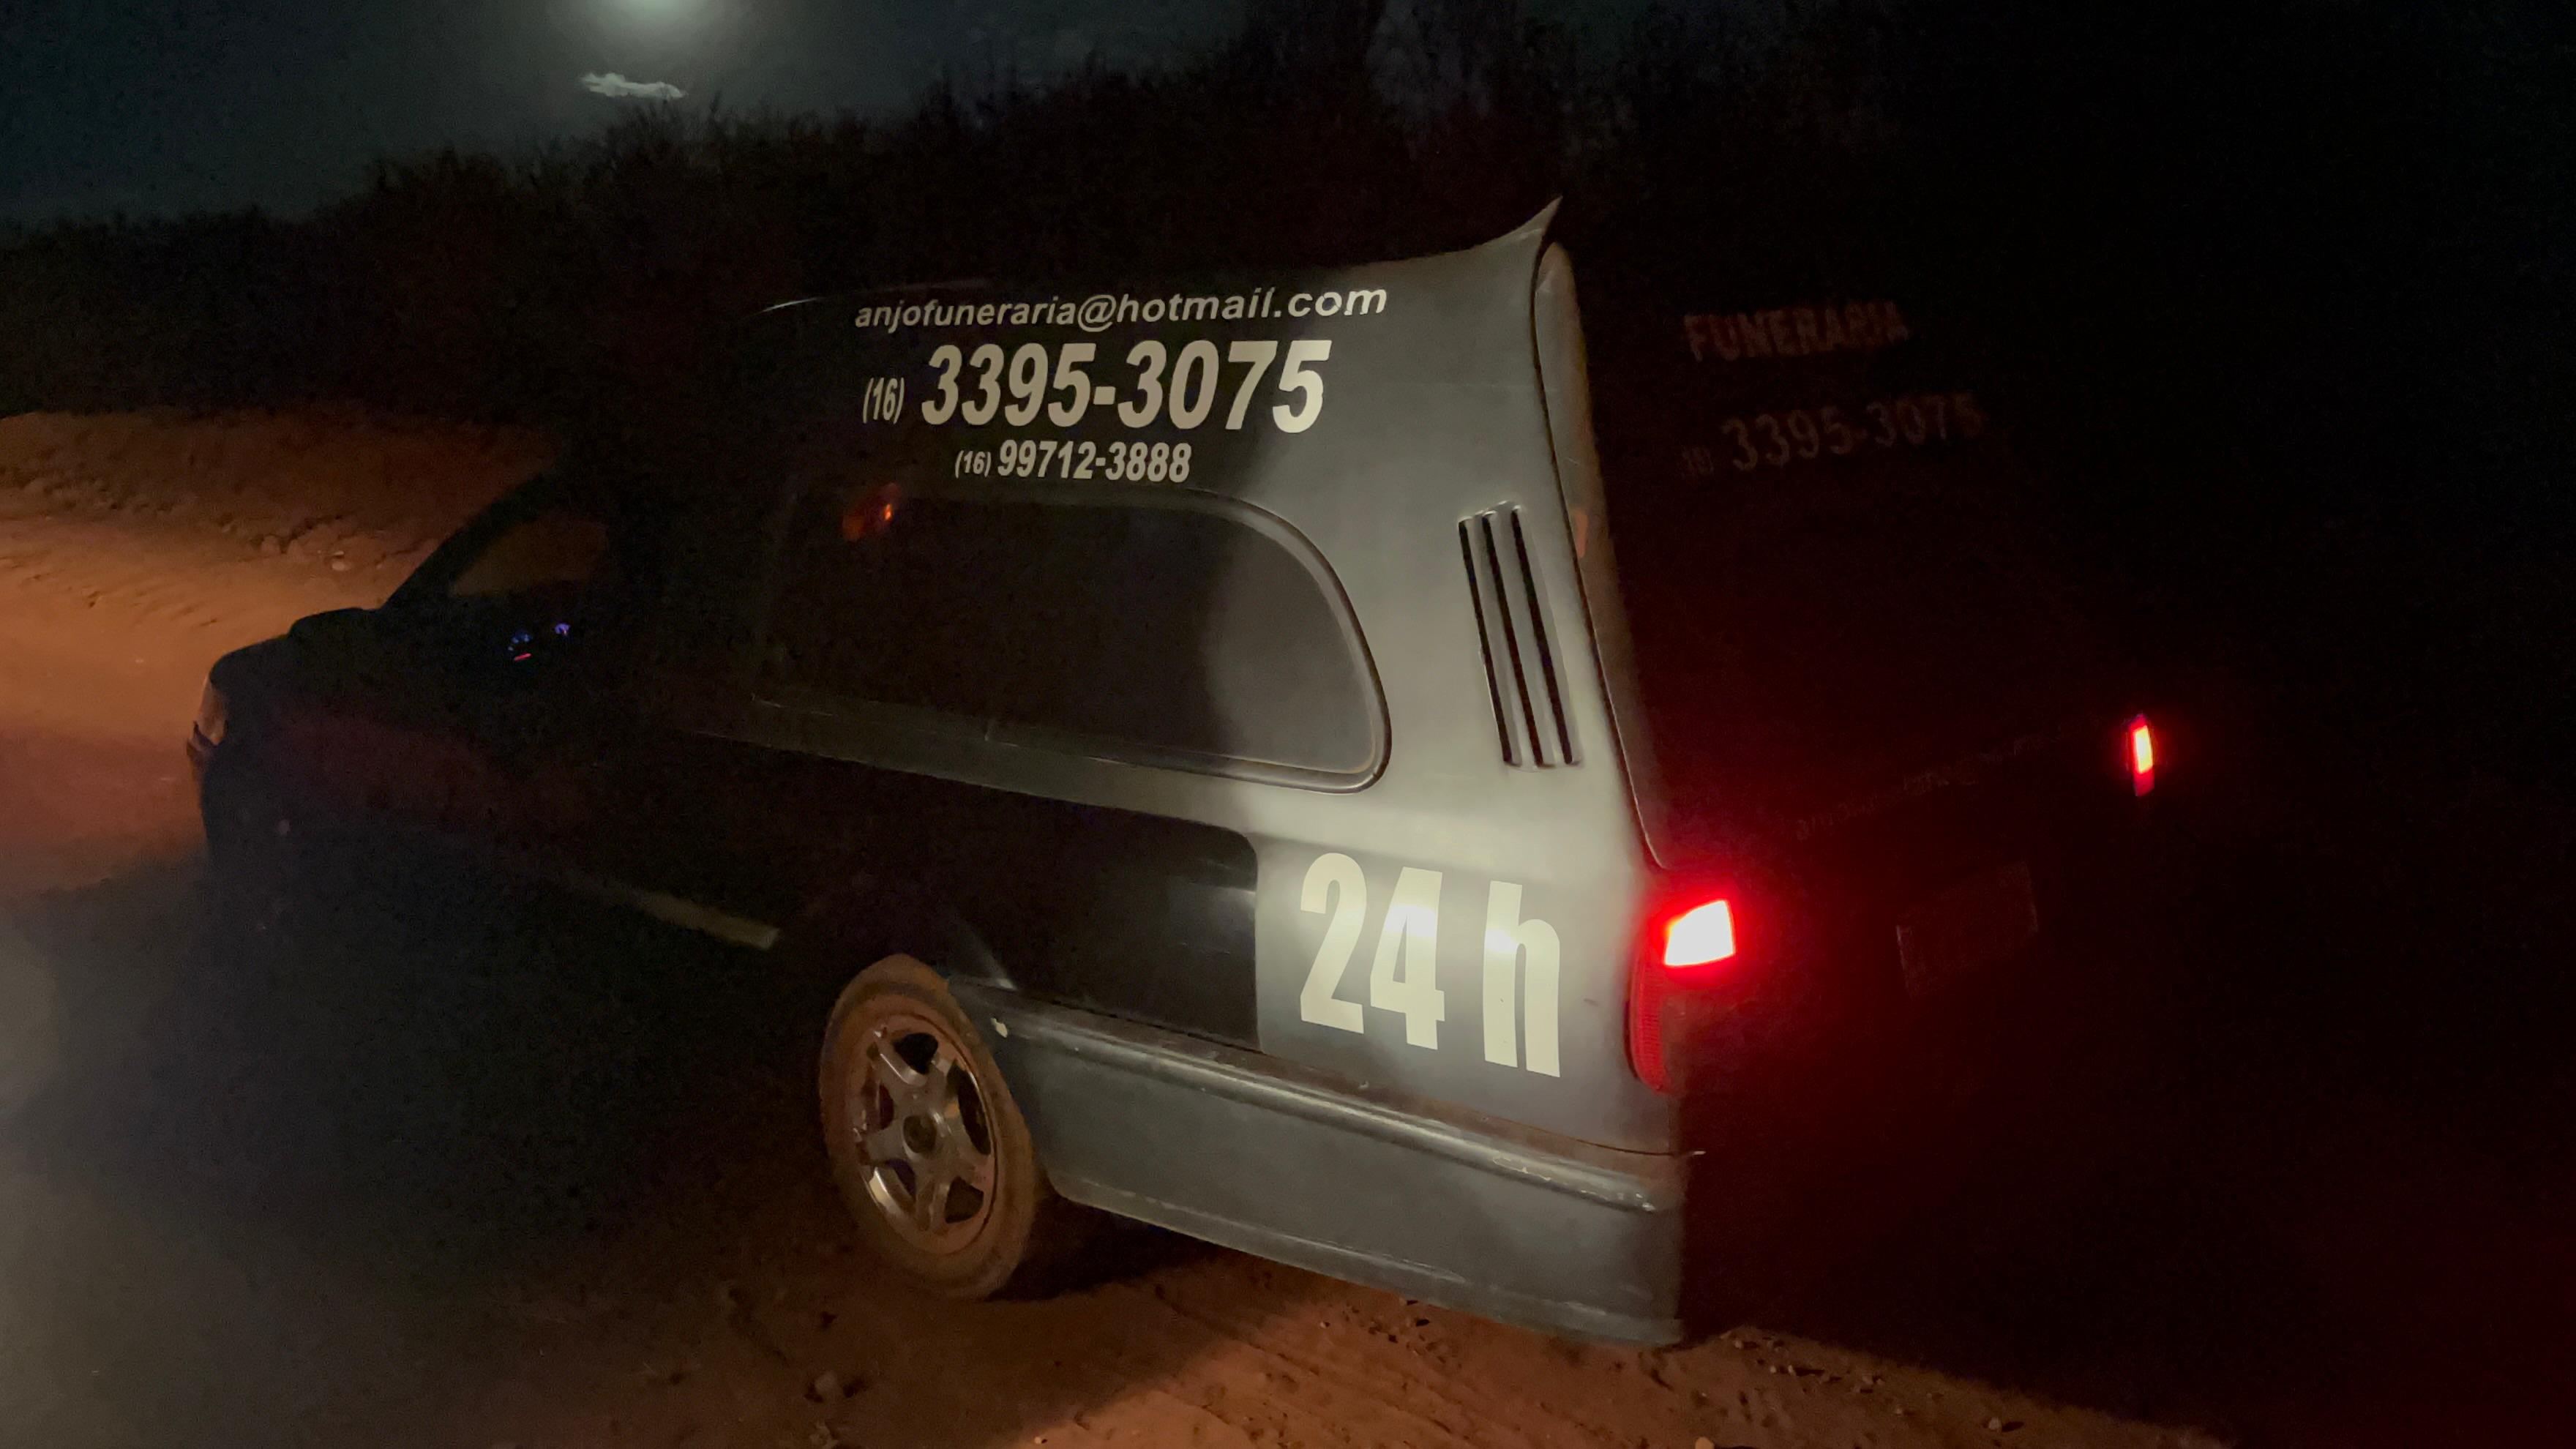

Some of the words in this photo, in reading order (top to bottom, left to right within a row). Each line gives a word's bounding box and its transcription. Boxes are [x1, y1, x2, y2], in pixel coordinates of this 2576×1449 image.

[855, 287, 1388, 334] anjofuneraria@hotmail.com
[862, 376, 905, 424] (16)
[921, 340, 1332, 433] 3395-3075
[954, 449, 992, 479] (16)
[997, 439, 1191, 483] 99712-3888
[1719, 391, 1988, 472] 3395-3075
[1300, 853, 1445, 1050] 24
[1483, 880, 1560, 1078] h
